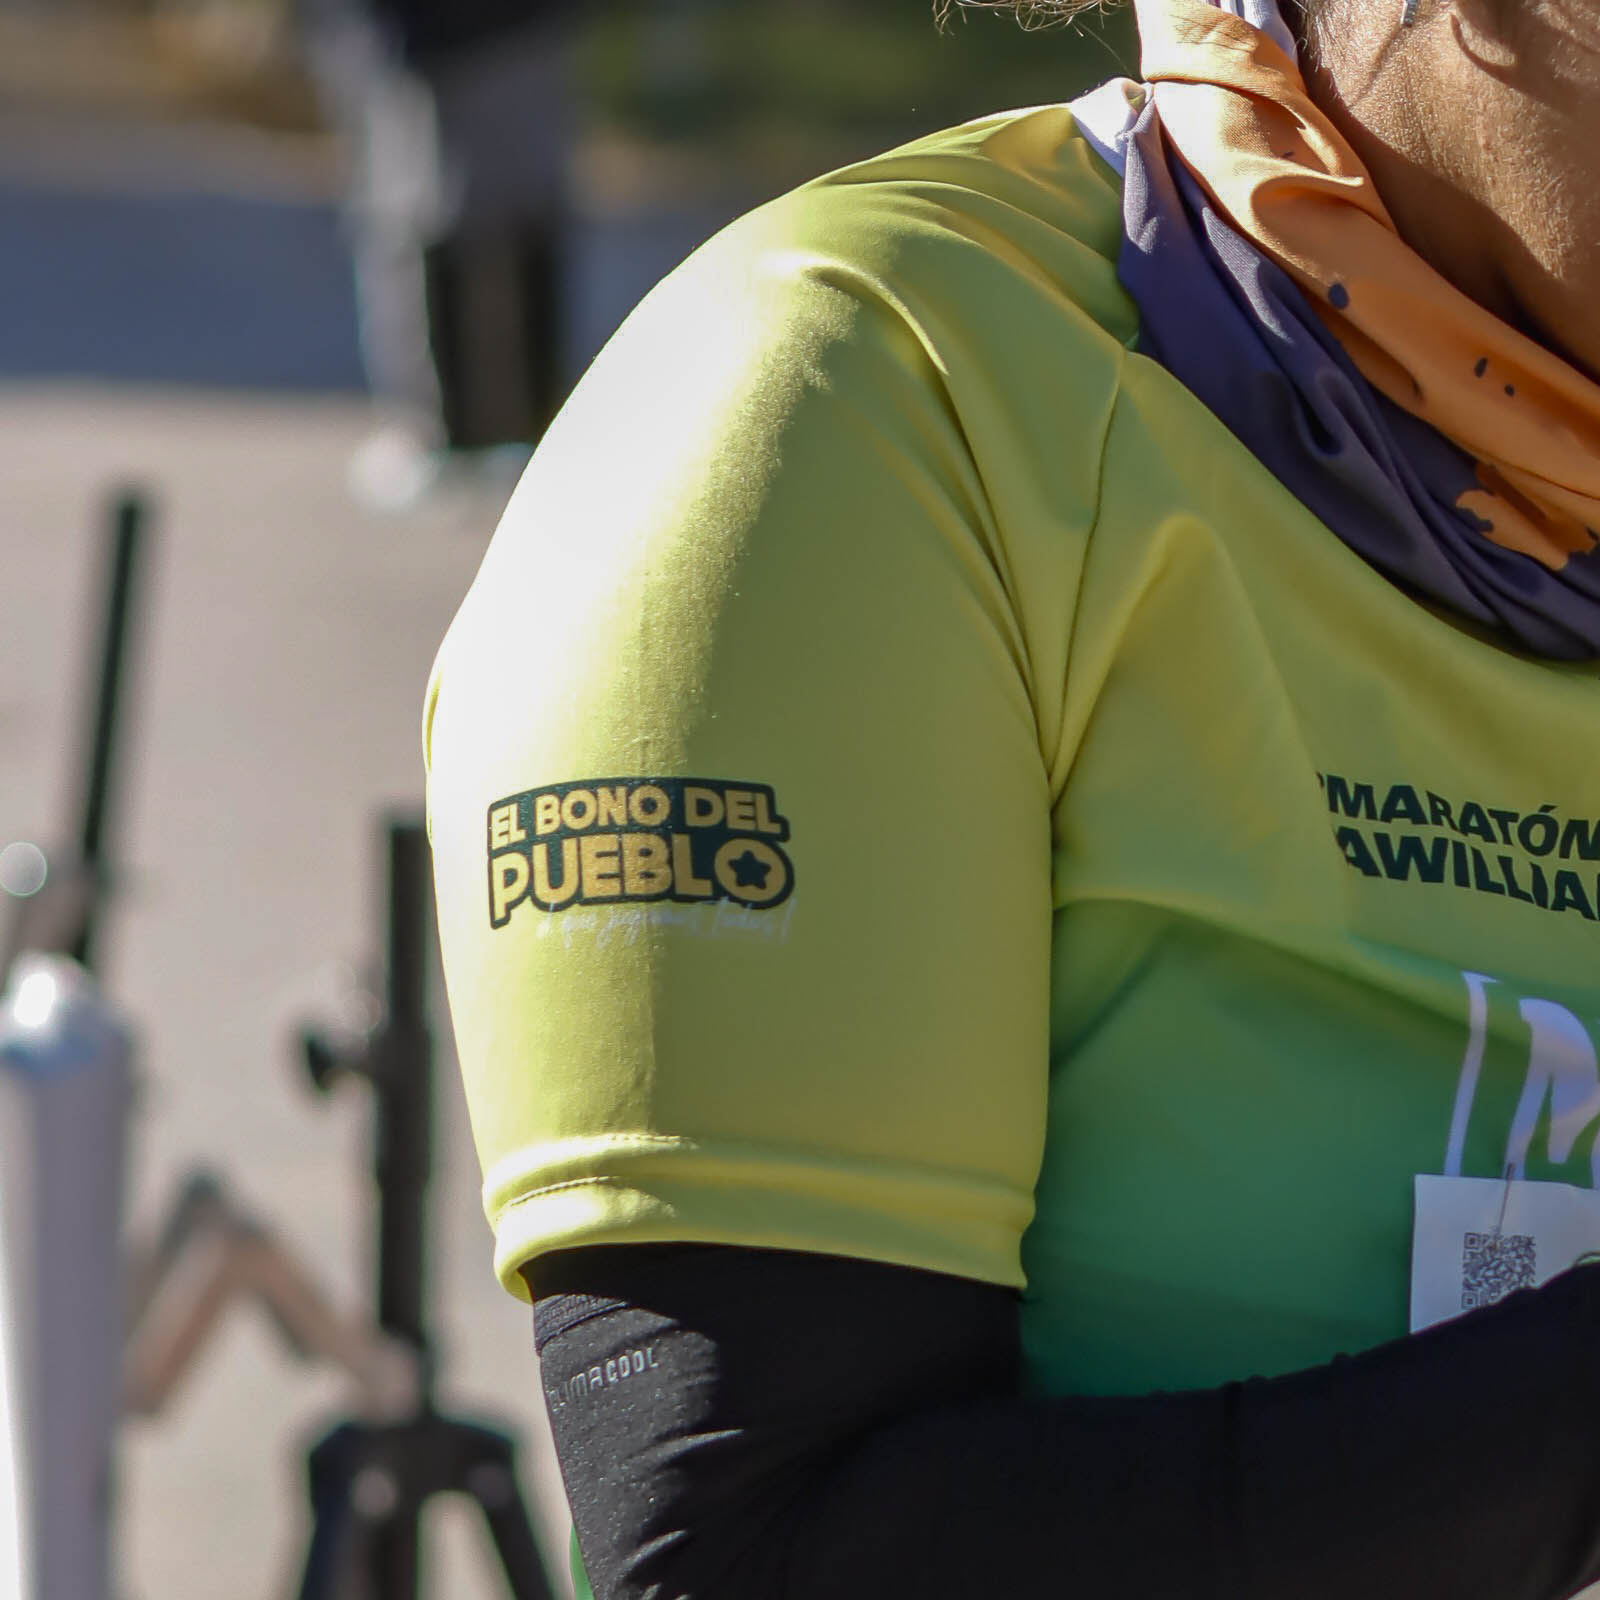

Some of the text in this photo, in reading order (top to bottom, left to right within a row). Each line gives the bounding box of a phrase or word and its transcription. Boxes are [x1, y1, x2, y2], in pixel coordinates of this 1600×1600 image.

[490, 784, 783, 851] EL BONO DEL
[490, 831, 788, 921] PUEBLO
